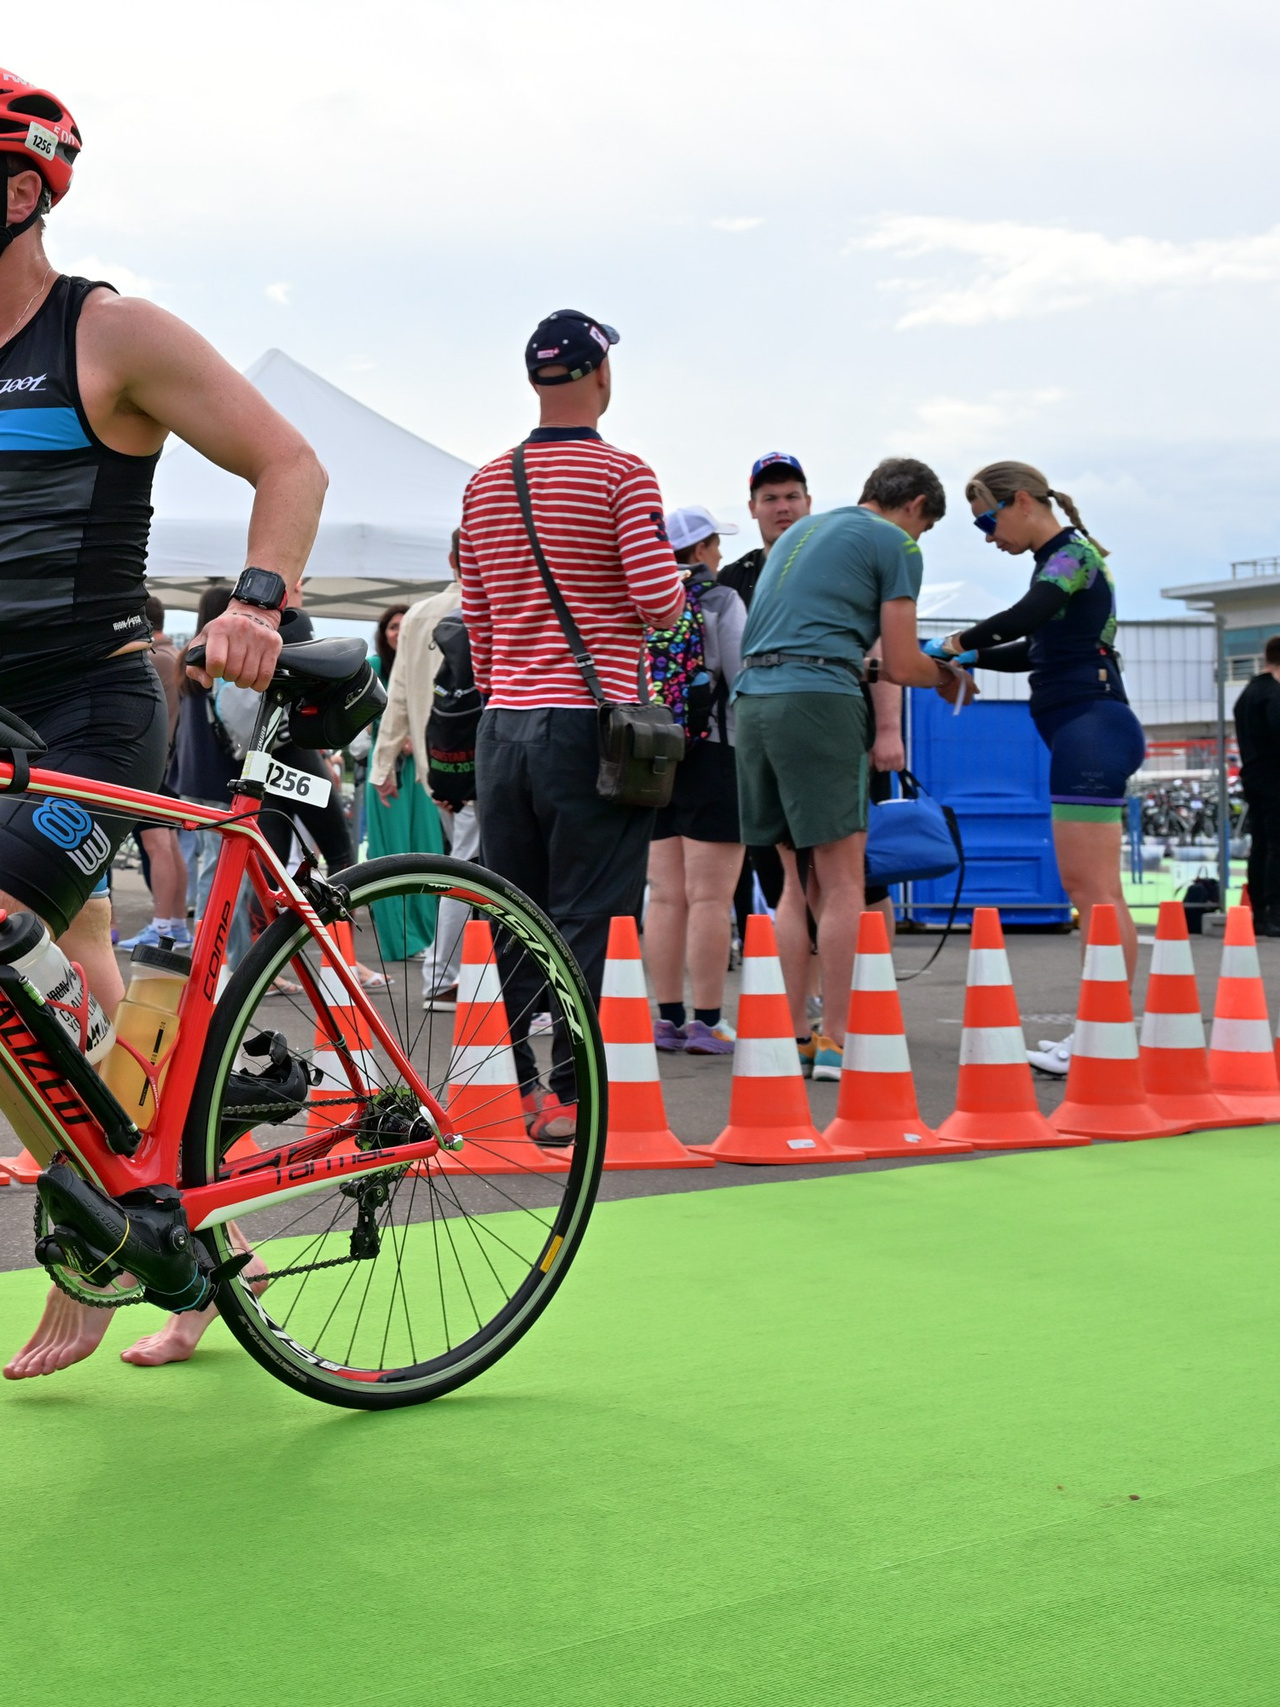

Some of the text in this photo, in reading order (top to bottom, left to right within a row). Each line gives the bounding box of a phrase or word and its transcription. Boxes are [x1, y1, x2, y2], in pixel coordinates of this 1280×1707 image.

[33, 134, 52, 154] 1256
[650, 512, 669, 541] 3
[265, 762, 311, 797] 1256
[510, 893, 538, 917] GRAND
[535, 914, 554, 935] PRIX
[203, 900, 231, 1001] COMP
